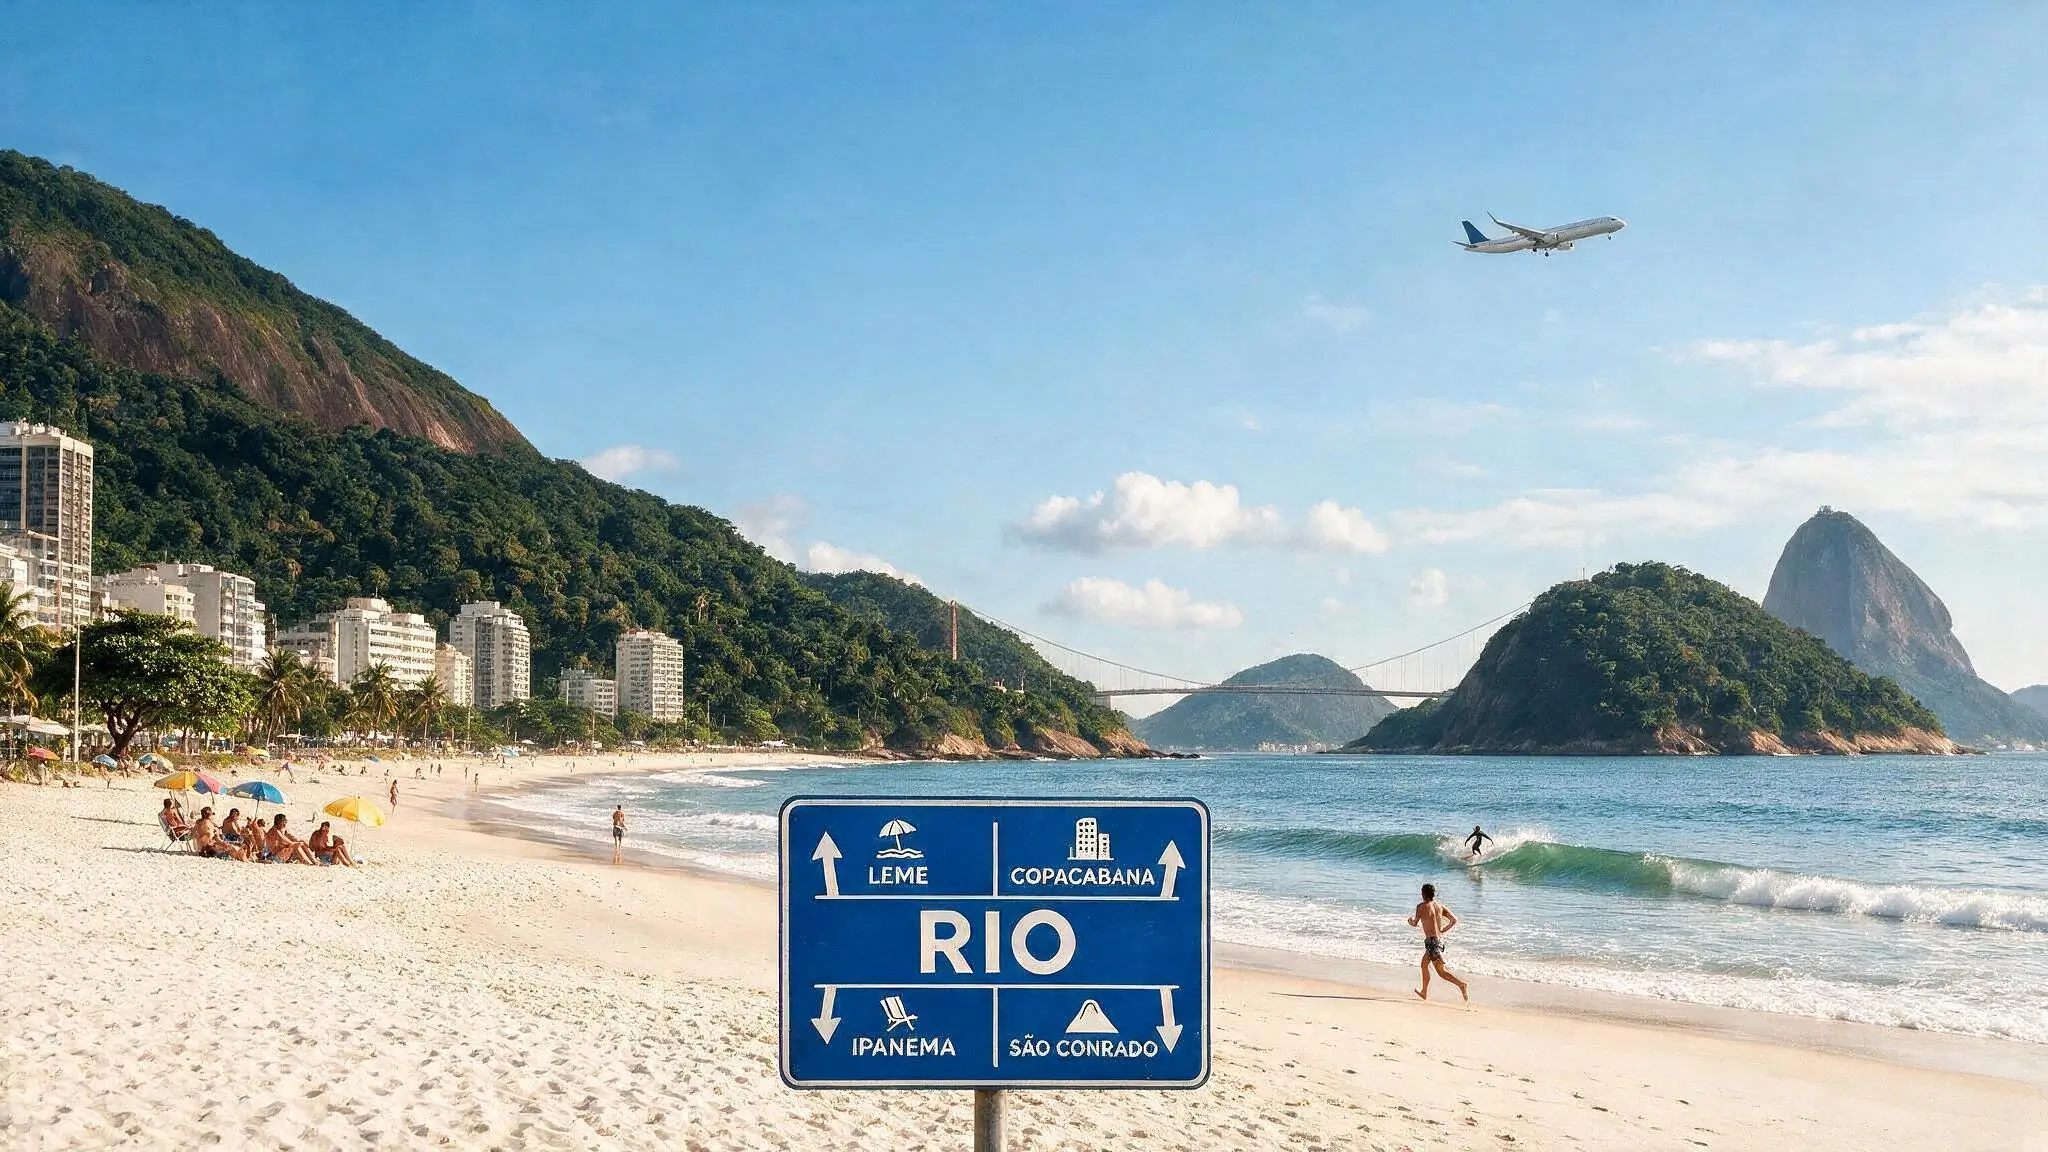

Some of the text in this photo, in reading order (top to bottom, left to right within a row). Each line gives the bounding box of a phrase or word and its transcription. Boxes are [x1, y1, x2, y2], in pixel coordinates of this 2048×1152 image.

[869, 867, 928, 884] LEME
[1011, 865, 1155, 886] COPACABANA
[921, 910, 1076, 974] RIO
[853, 1038, 955, 1056] IPANEMA
[1010, 1034, 1158, 1057] SÃO CONRADO
